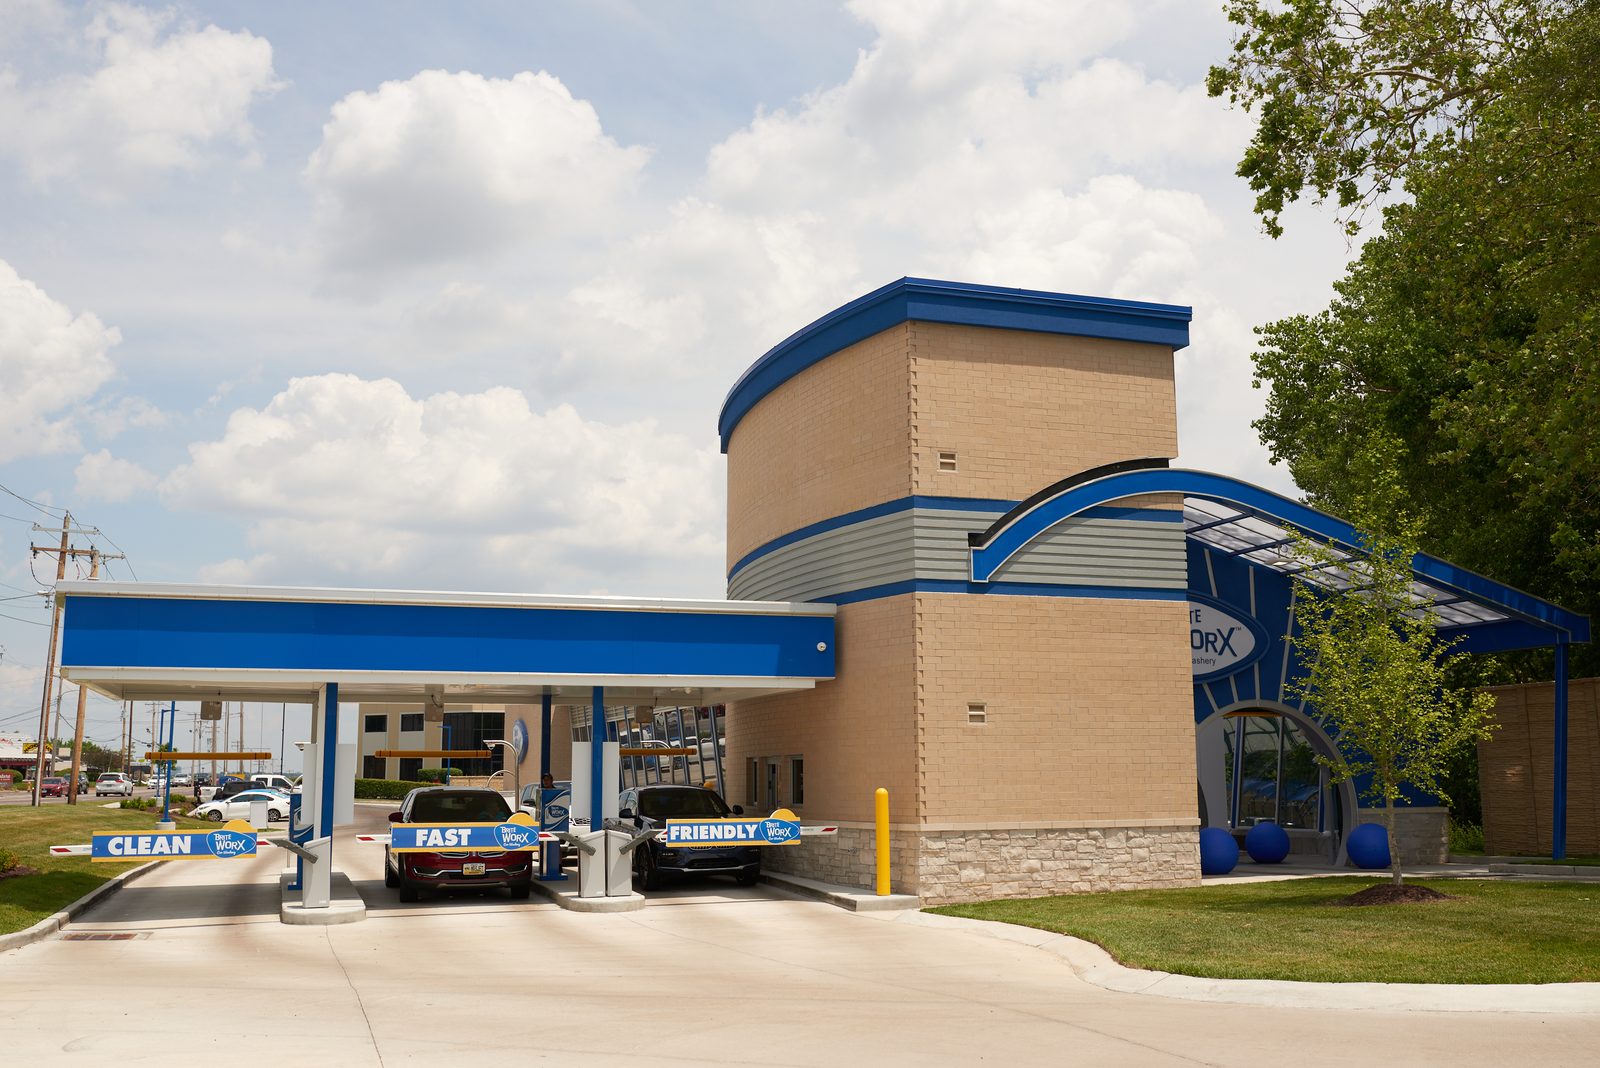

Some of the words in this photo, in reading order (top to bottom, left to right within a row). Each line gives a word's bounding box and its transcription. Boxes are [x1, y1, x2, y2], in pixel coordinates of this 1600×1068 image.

[1190, 627, 1237, 657] ORX
[1191, 656, 1216, 666] ashery
[500, 826, 516, 834] BRITE
[765, 821, 780, 829] BRITE
[213, 833, 232, 841] BRITE
[416, 829, 471, 846] FAST
[502, 832, 529, 844] WORX
[670, 825, 758, 840] FRIENDLY
[767, 827, 792, 838] WORX
[108, 836, 191, 855] CLEAN
[215, 840, 246, 851] WORX
